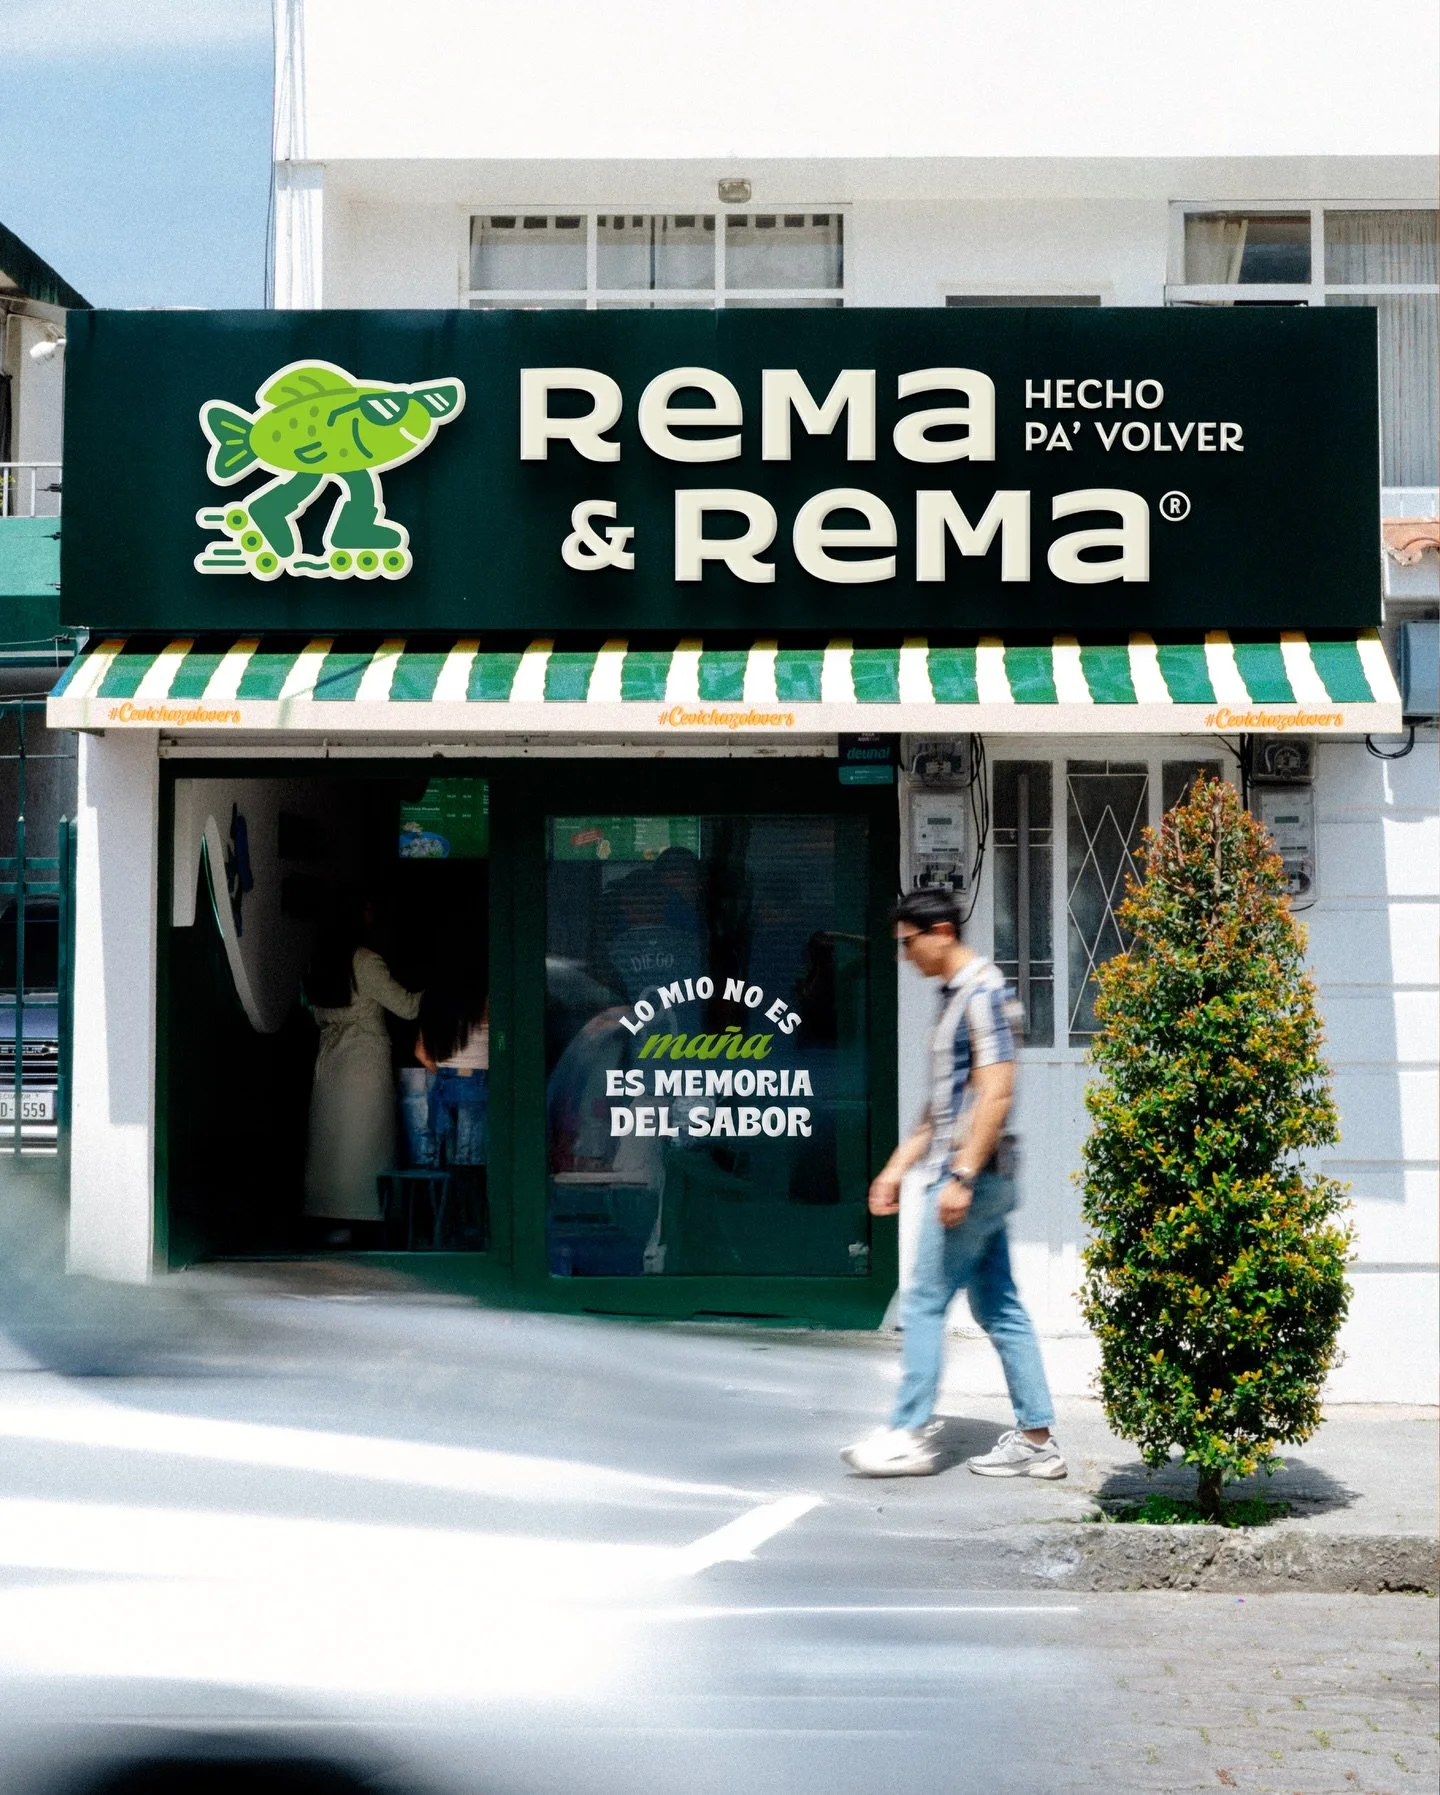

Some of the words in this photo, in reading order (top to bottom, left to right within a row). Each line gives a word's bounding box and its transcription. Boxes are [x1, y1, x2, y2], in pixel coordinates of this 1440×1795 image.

[1025, 379, 1164, 410] HECHO
[1025, 421, 1081, 452] PA'
[1094, 421, 1244, 452] VOLVER
[561, 499, 635, 571] &
[657, 705, 796, 730] #Cevichazolovers
[619, 1000, 655, 1035] LO
[657, 976, 714, 1009] MIO
[722, 977, 763, 1008] NO
[764, 998, 802, 1035] ES
[638, 1025, 774, 1060] maña
[605, 1069, 645, 1097] ES
[654, 1069, 814, 1097] MEMORIA
[610, 1106, 680, 1137] DEL
[687, 1106, 812, 1138] SABOR
